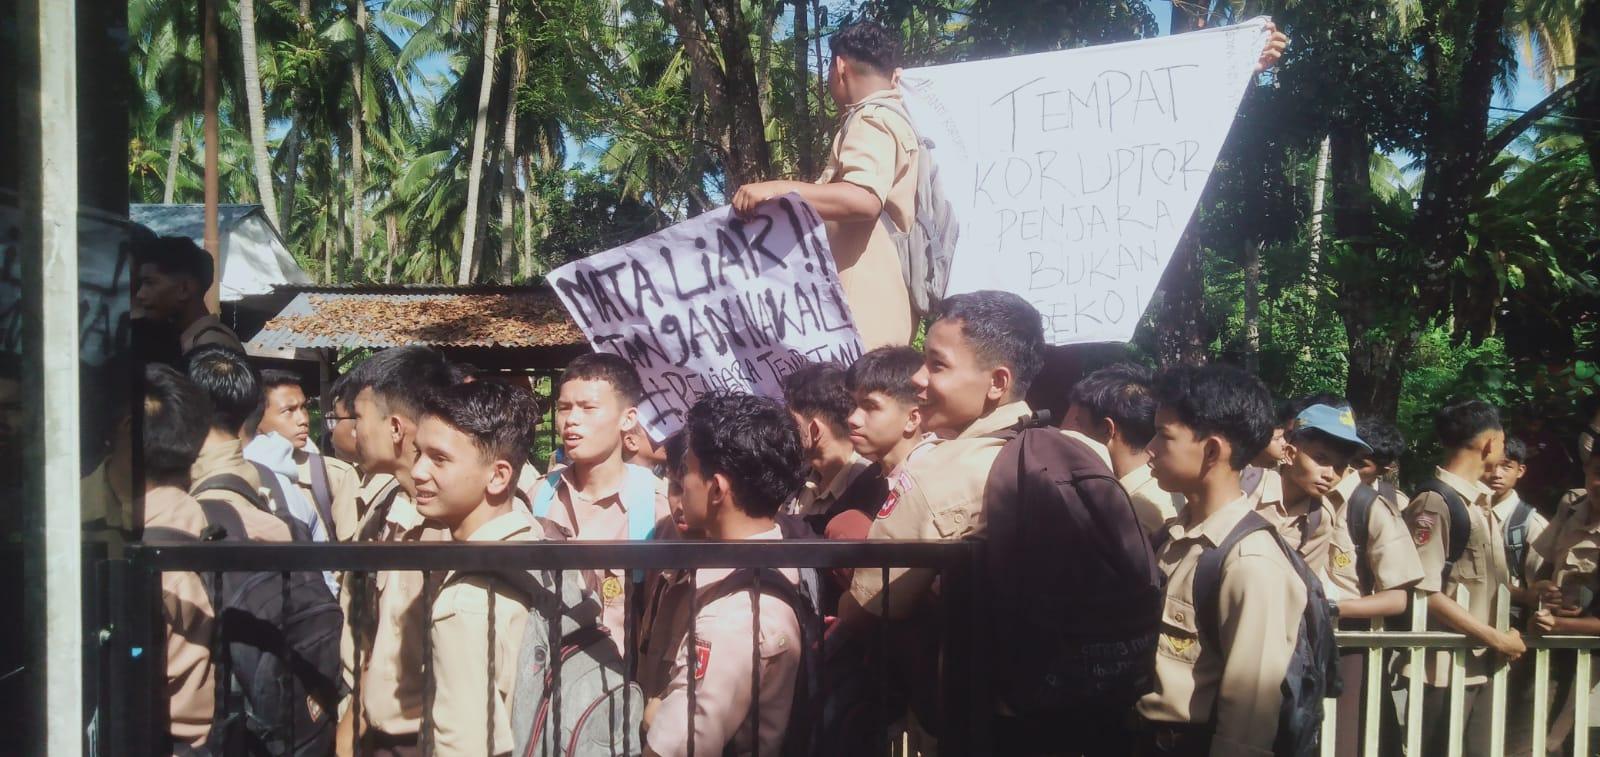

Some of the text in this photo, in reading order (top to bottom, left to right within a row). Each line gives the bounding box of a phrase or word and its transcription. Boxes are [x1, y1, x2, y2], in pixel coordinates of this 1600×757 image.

[990, 64, 1199, 152] TEMPAT
[973, 140, 1210, 208] KORUPTOR
[995, 199, 1175, 252] PENJARA
[555, 259, 664, 327] MATA
[1027, 239, 1160, 291] BUKAN
